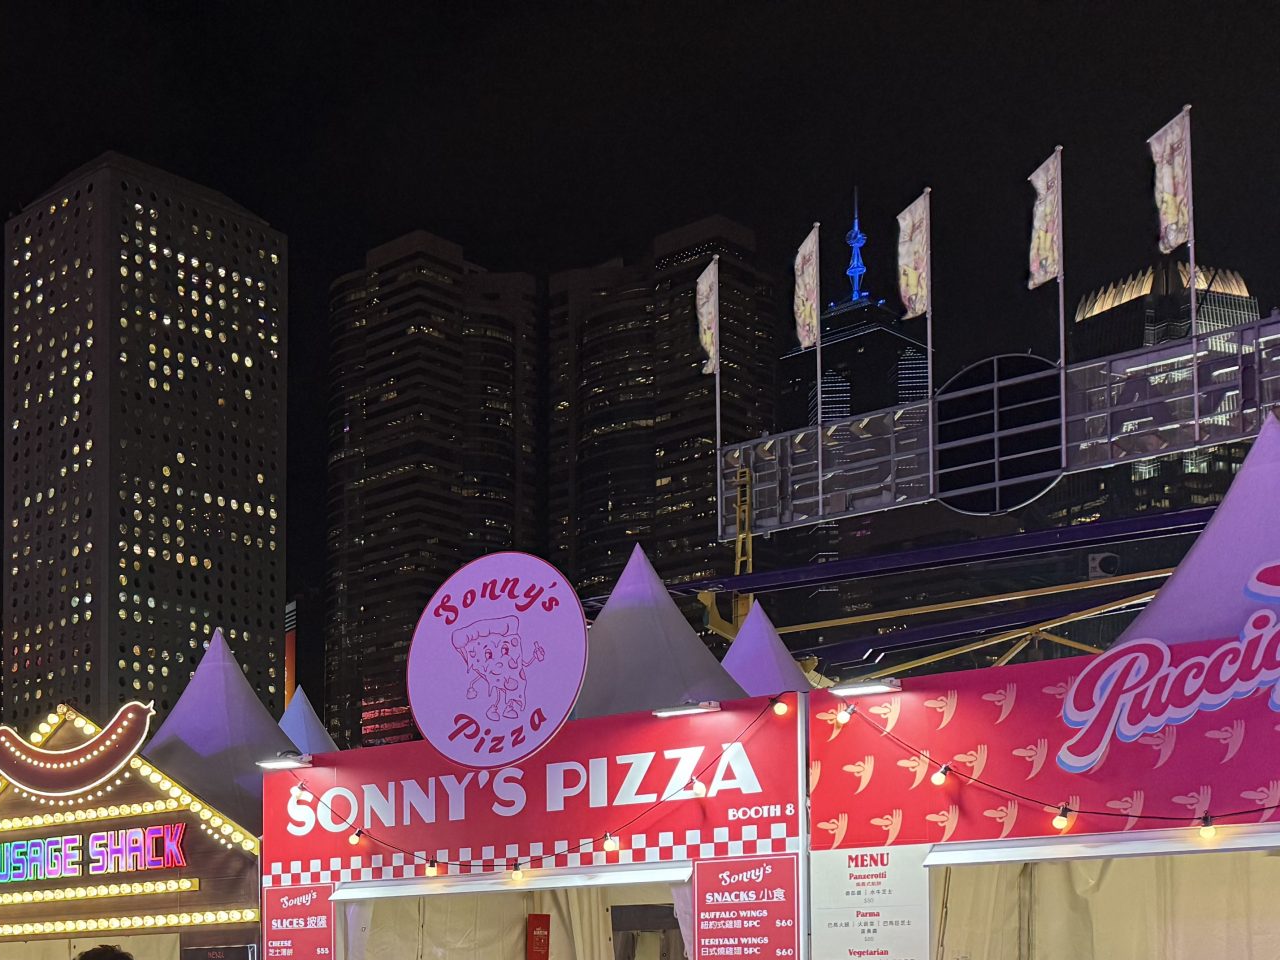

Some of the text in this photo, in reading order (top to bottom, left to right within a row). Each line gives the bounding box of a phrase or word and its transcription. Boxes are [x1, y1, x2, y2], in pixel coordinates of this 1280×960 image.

[432, 577, 560, 626] Sonny's
[447, 706, 548, 755] Pizza
[285, 741, 763, 837] SONNY'S PIZZA
[727, 803, 795, 821] BOOTH 8
[89, 822, 188, 876] SHACK
[847, 852, 890, 868] MENU
[718, 862, 773, 886] Sonny's
[280, 890, 317, 908] Sonny's
[705, 887, 786, 903] SNACKS 小食
[700, 909, 768, 919] BUFFALO WINGS
[856, 910, 880, 918] Parma
[271, 918, 304, 929] SLICES
[743, 919, 761, 928] 5PC
[775, 919, 793, 927] $60
[740, 936, 769, 944] WINGS
[743, 946, 761, 954] 5PC
[775, 948, 793, 956] $60
[848, 948, 889, 958] Vegetarian
